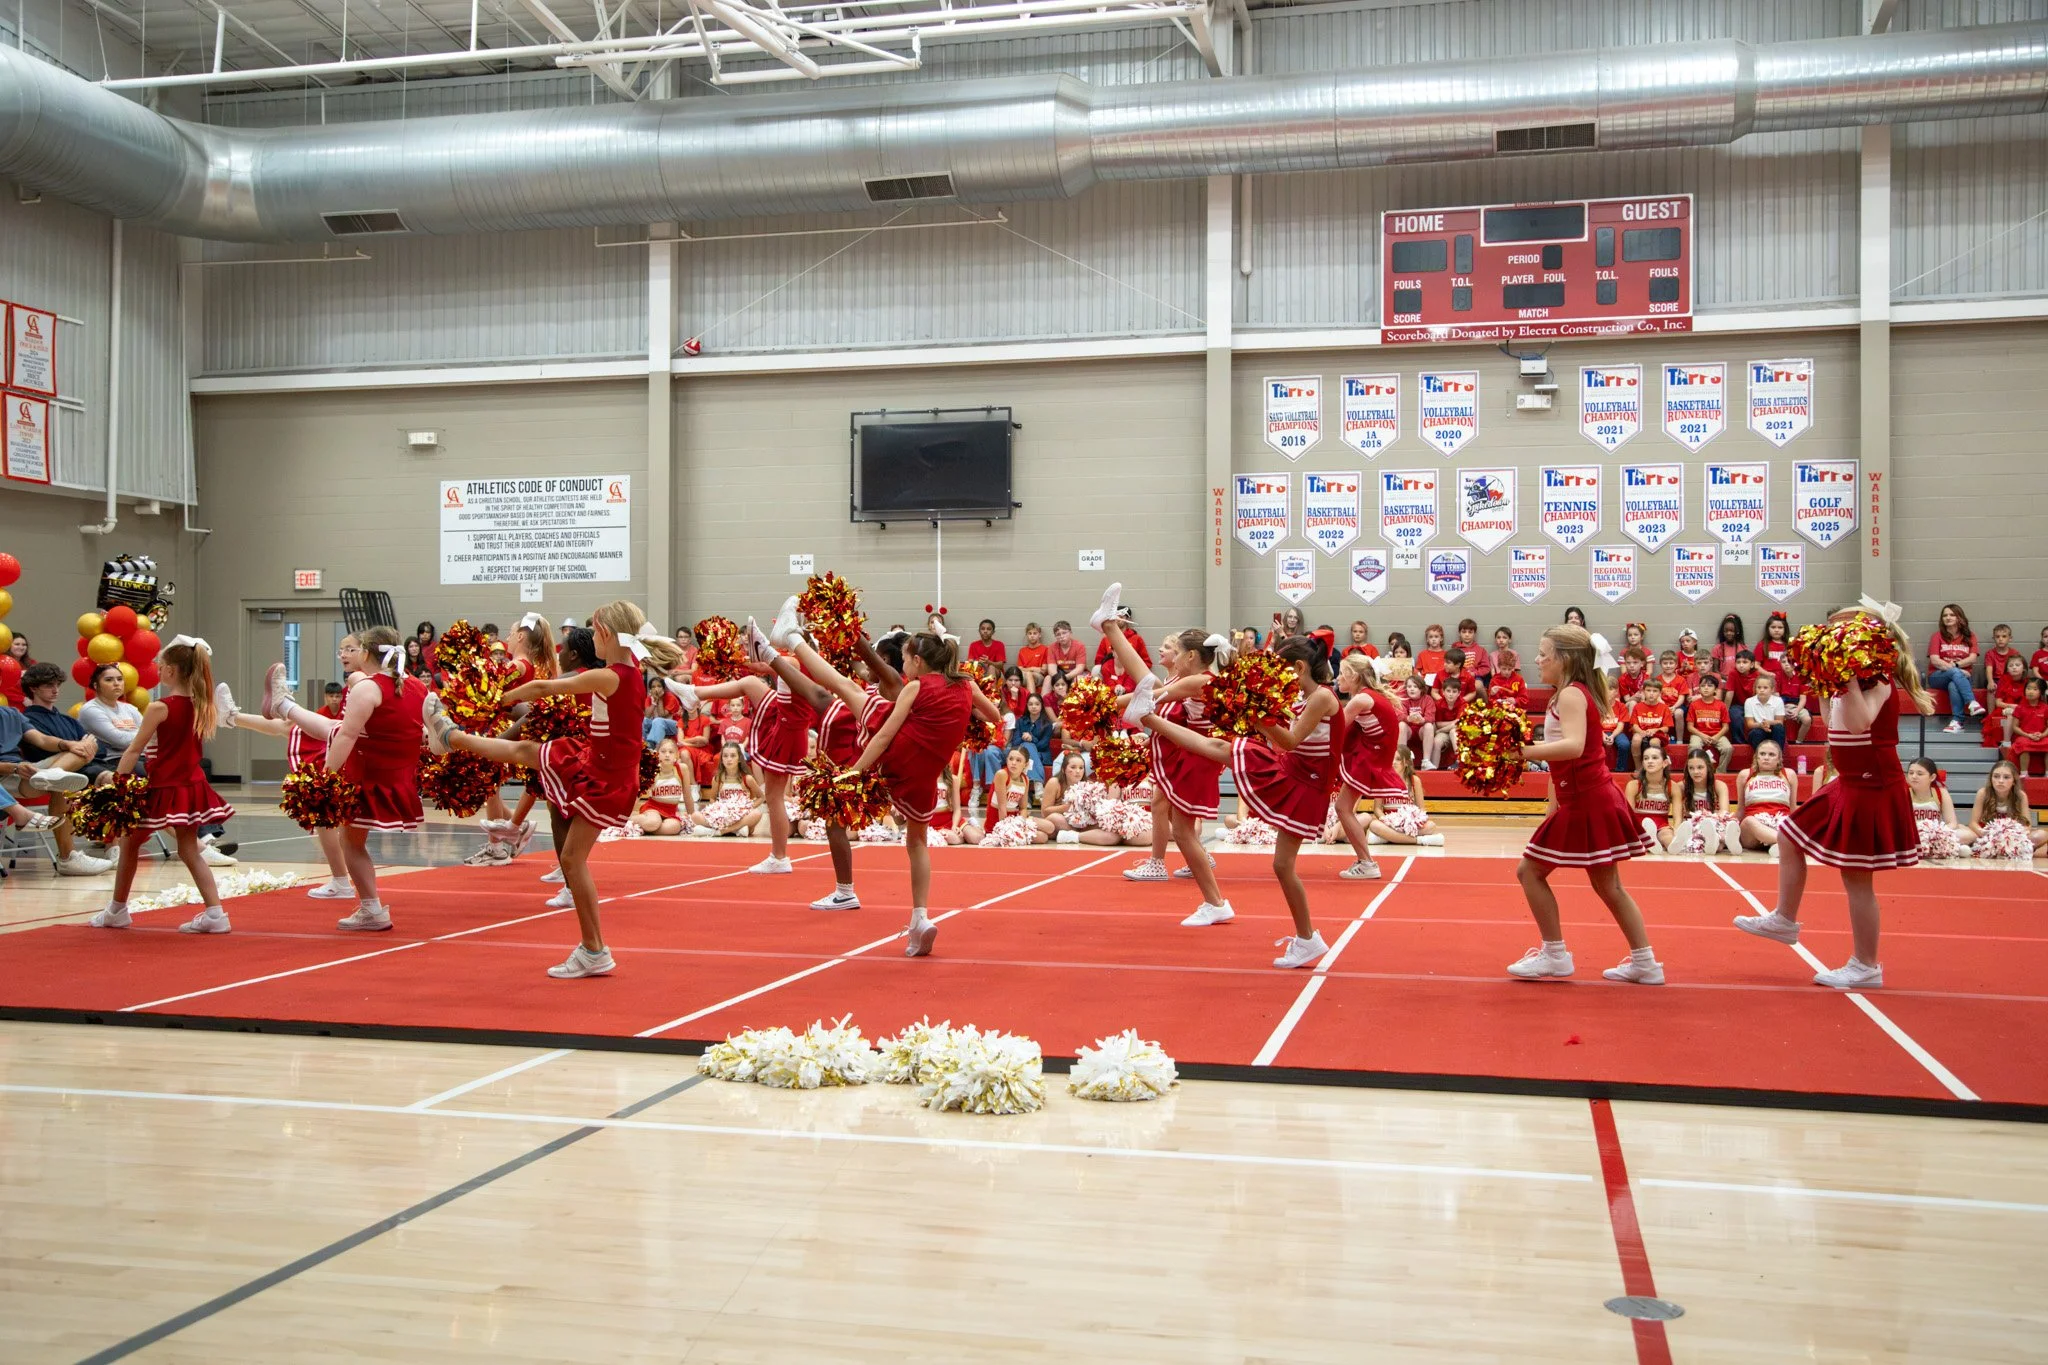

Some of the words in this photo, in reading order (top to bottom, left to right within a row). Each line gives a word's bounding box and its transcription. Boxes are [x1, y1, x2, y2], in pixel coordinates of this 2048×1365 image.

[1622, 202, 1681, 220] GUEST
[1395, 215, 1444, 232] HOME
[1508, 254, 1540, 264] PERIOD
[1596, 271, 1619, 280] T.O.L.
[1650, 267, 1678, 277] FOULS
[1451, 278, 1473, 287] T.O.L.
[1502, 274, 1534, 284] PLAYER
[1544, 273, 1566, 282] FOUL
[1394, 280, 1421, 289] FOULS
[1649, 303, 1678, 312] SCORE
[1394, 314, 1421, 323] SCORE
[1519, 309, 1548, 318] MATCH
[1387, 330, 1448, 340] Scoreboard
[1452, 327, 1498, 338] Donated
[1502, 327, 1515, 338] by
[1519, 326, 1557, 336] Electra
[1560, 322, 1634, 334] Construction
[1638, 320, 1660, 331] Co.,
[1664, 320, 1686, 330] Inc.
[1585, 401, 1637, 412] VOLLEYBALL
[1668, 400, 1721, 411] BASKETBALL
[1753, 398, 1771, 406] GIRLS
[1773, 397, 1807, 406] ATHLETICS
[1270, 412, 1283, 422] SAND
[1284, 411, 1317, 421] VOLLEYBALL
[1347, 410, 1395, 420] VOLLEYBALL
[1424, 407, 1473, 417] VOLLEYBALL
[1668, 410, 1721, 422] RUNNERUP
[1753, 406, 1807, 417] CHAMPION
[1423, 417, 1473, 428] CHAMPION
[1585, 412, 1636, 424] CHAMPION
[1269, 421, 1318, 433] CHAMPIONS
[1346, 420, 1395, 431] CHAMPION
[1597, 426, 1624, 434] 2021
[1680, 424, 1707, 433] 2021
[1766, 421, 1793, 430] 2021
[1366, 431, 1377, 439] 1A
[1436, 430, 1462, 439] 2020
[1281, 435, 1306, 446] 2018
[1360, 440, 1381, 448] 2018
[467, 482, 515, 495] ATHLETICS
[518, 481, 542, 493] CODE
[546, 480, 557, 492] OF
[560, 479, 603, 492] CONDUCT
[1545, 501, 1596, 511] TENNIS
[1626, 500, 1678, 511] VOLLEYBALL
[1710, 500, 1763, 510] VOLLEYBALL
[1810, 497, 1841, 508] GOLF
[1238, 507, 1286, 518] VOLLEYBALL
[1307, 507, 1356, 517] BASKETBALL
[1384, 505, 1434, 515] BASKETBALL
[1798, 508, 1853, 519] CHAMPION
[1869, 473, 1882, 557] WARRIORS
[1384, 515, 1434, 526] CHAMPIONS
[1544, 511, 1596, 522] CHAMPION
[1625, 511, 1678, 522] CHAMPION
[1709, 510, 1763, 521] CHAMPION
[1213, 488, 1224, 566] WARRIORS
[1237, 518, 1286, 529] CHAMPION
[1307, 517, 1356, 528] CHAMPIONS
[1461, 520, 1512, 532] CHAMPION
[1811, 522, 1840, 531] 2025
[1396, 528, 1422, 537] 2022
[1556, 525, 1583, 534] 2023
[1638, 524, 1666, 533] 2023
[1722, 524, 1750, 533] 2024
[535, 532, 559, 540] COACHES
[1250, 531, 1274, 539] 2022
[1318, 530, 1344, 539] 2022
[554, 540, 564, 548] AND
[454, 554, 471, 562] CHEER
[548, 552, 559, 560] AND
[560, 551, 598, 559] ENCOURAGING
[523, 565, 548, 573] PROPERTY
[568, 564, 587, 572] SCHOOL
[1432, 564, 1446, 572] TEAM
[1447, 563, 1465, 571] TENNIS
[300, 573, 316, 586] EXIT
[108, 579, 153, 592] HOLLYWOOD
[1280, 582, 1312, 590] CHAMPION
[1749, 779, 1787, 792] WARRIORS
[652, 785, 682, 797] WARRIORS
[1635, 800, 1669, 810] WARRIORS
